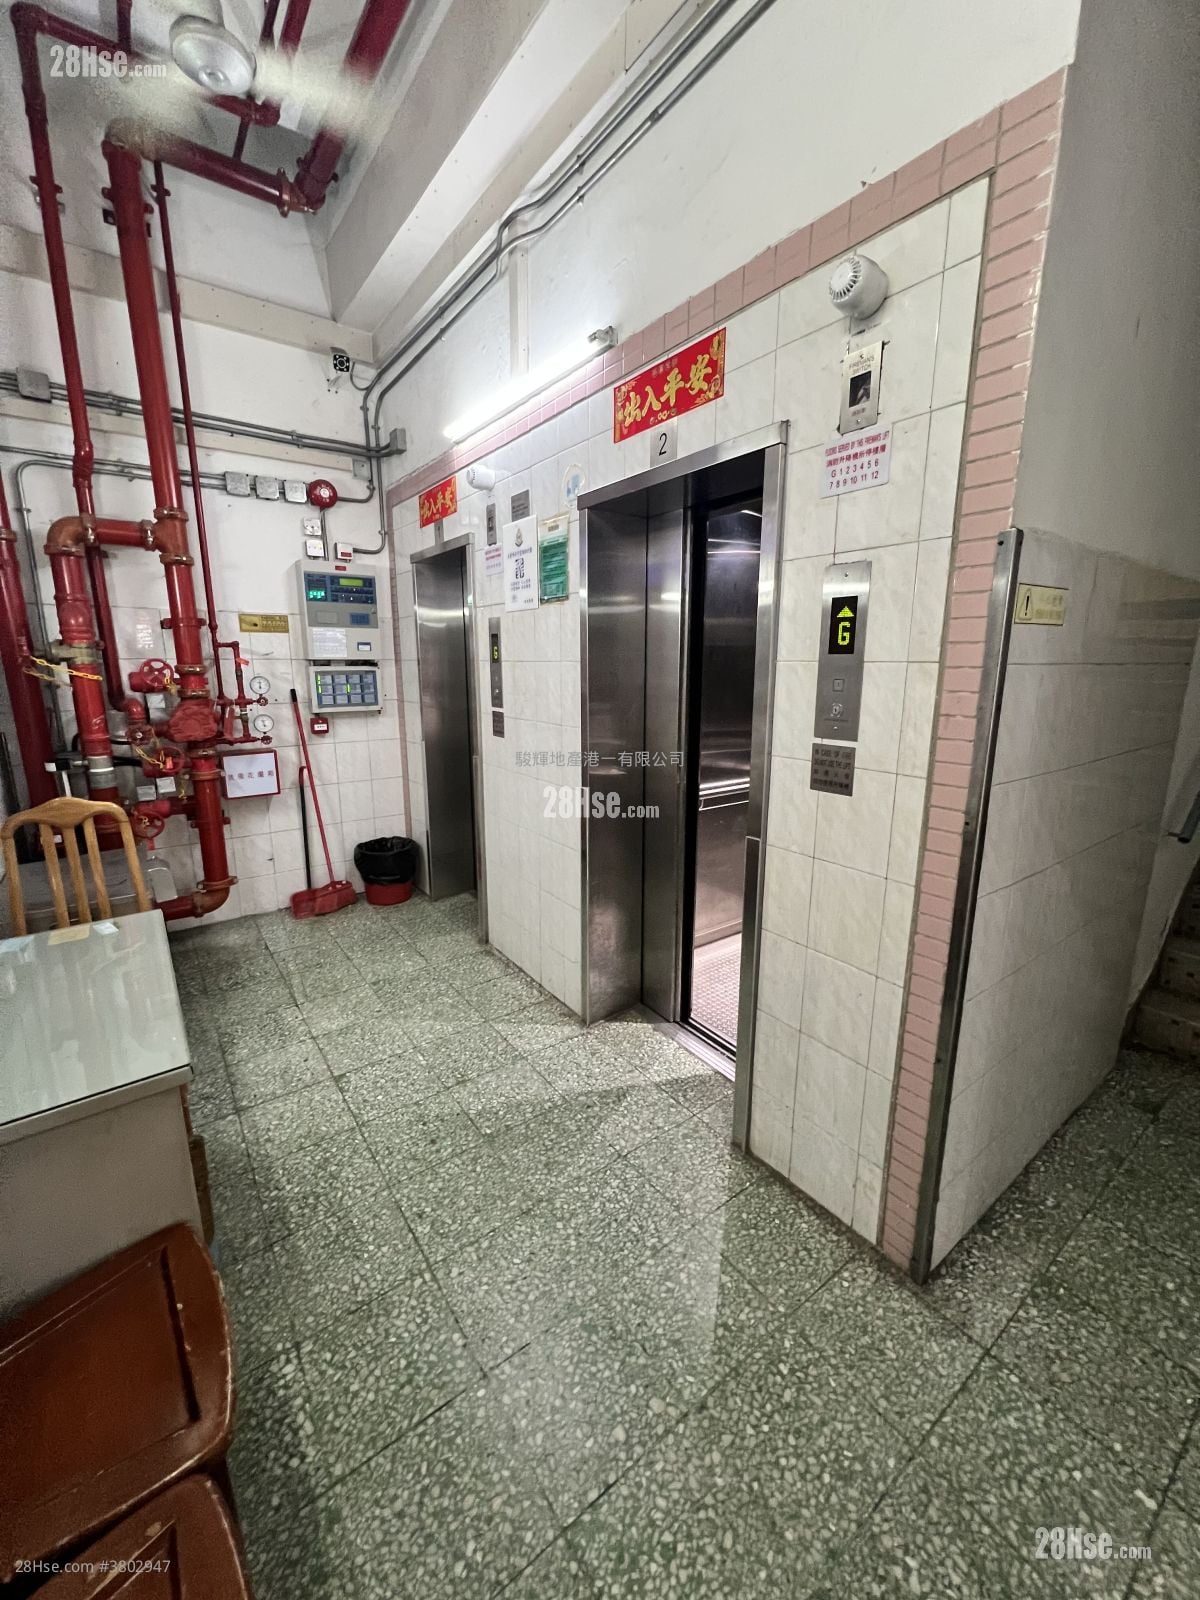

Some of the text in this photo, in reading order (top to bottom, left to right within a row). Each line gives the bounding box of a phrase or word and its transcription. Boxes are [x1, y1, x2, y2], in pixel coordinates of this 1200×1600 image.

[623, 353, 713, 428] 出入平安
[658, 432, 668, 456] 2
[830, 470, 879, 490] 7 8 9 10 11 12
[831, 469, 837, 478] G
[846, 466, 850, 475] 2
[853, 464, 857, 473] 3
[860, 462, 864, 470] 4
[867, 460, 871, 469] 5
[874, 458, 879, 467] 6
[837, 621, 851, 646] G
